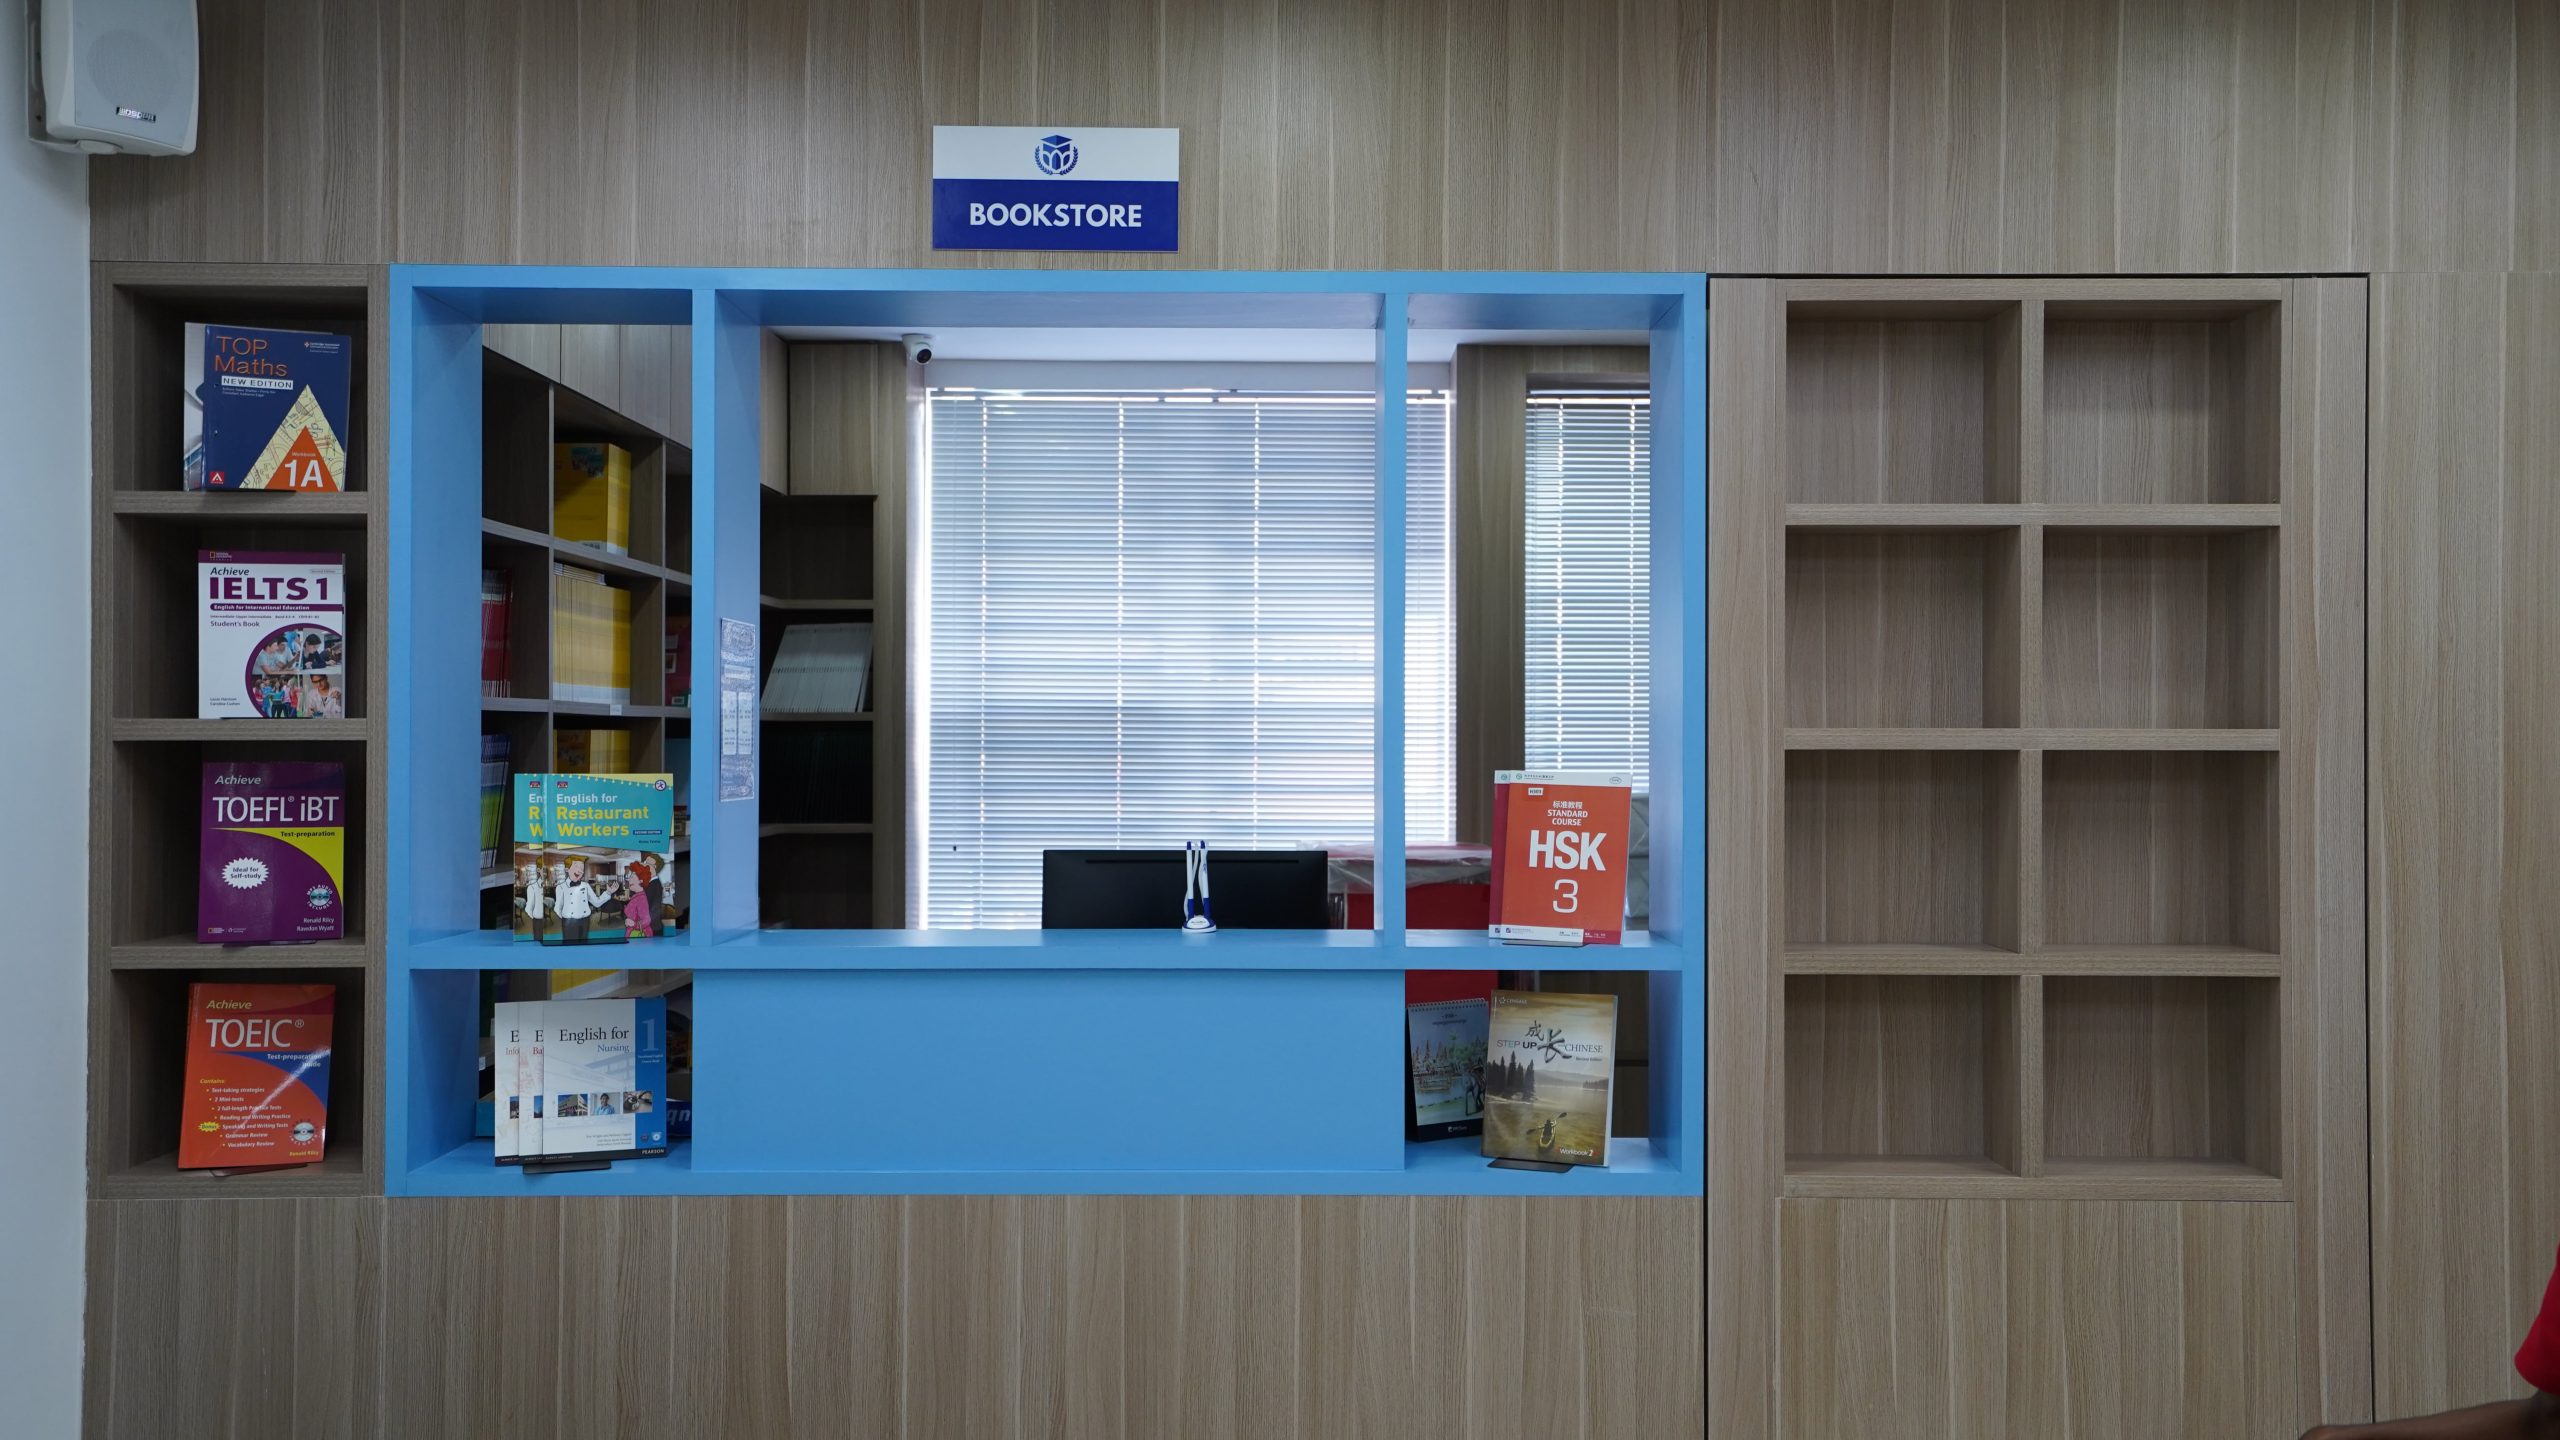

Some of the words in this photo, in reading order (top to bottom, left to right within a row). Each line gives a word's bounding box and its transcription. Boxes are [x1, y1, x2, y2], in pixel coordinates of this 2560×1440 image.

[970, 203, 1142, 227] BOOKSTORE
[216, 336, 268, 355] TOP
[214, 355, 287, 376] Maths
[250, 380, 292, 388] EDITION
[285, 460, 323, 487] 1A
[210, 567, 249, 576] Achieve
[210, 577, 308, 600] IELTS
[316, 578, 327, 600] 1
[215, 776, 262, 785] Achieve
[557, 794, 598, 805] English
[601, 794, 617, 803] for
[1553, 801, 1582, 809] 标准教程
[300, 796, 339, 822] iBT
[557, 806, 648, 820] Restaurant
[1547, 810, 1588, 818] STANDARD
[1552, 818, 1581, 826] COURSE
[557, 823, 629, 837] Workers
[1529, 830, 1607, 871] HSK
[1553, 879, 1578, 913] 3
[206, 1000, 252, 1009] Achieve
[560, 1028, 606, 1044] English
[612, 1027, 629, 1039] for
[642, 1019, 658, 1051] 1
[597, 1045, 629, 1053] Nursing
[1497, 1040, 1520, 1048] STEP
[1564, 1044, 1603, 1053] CHINESE
